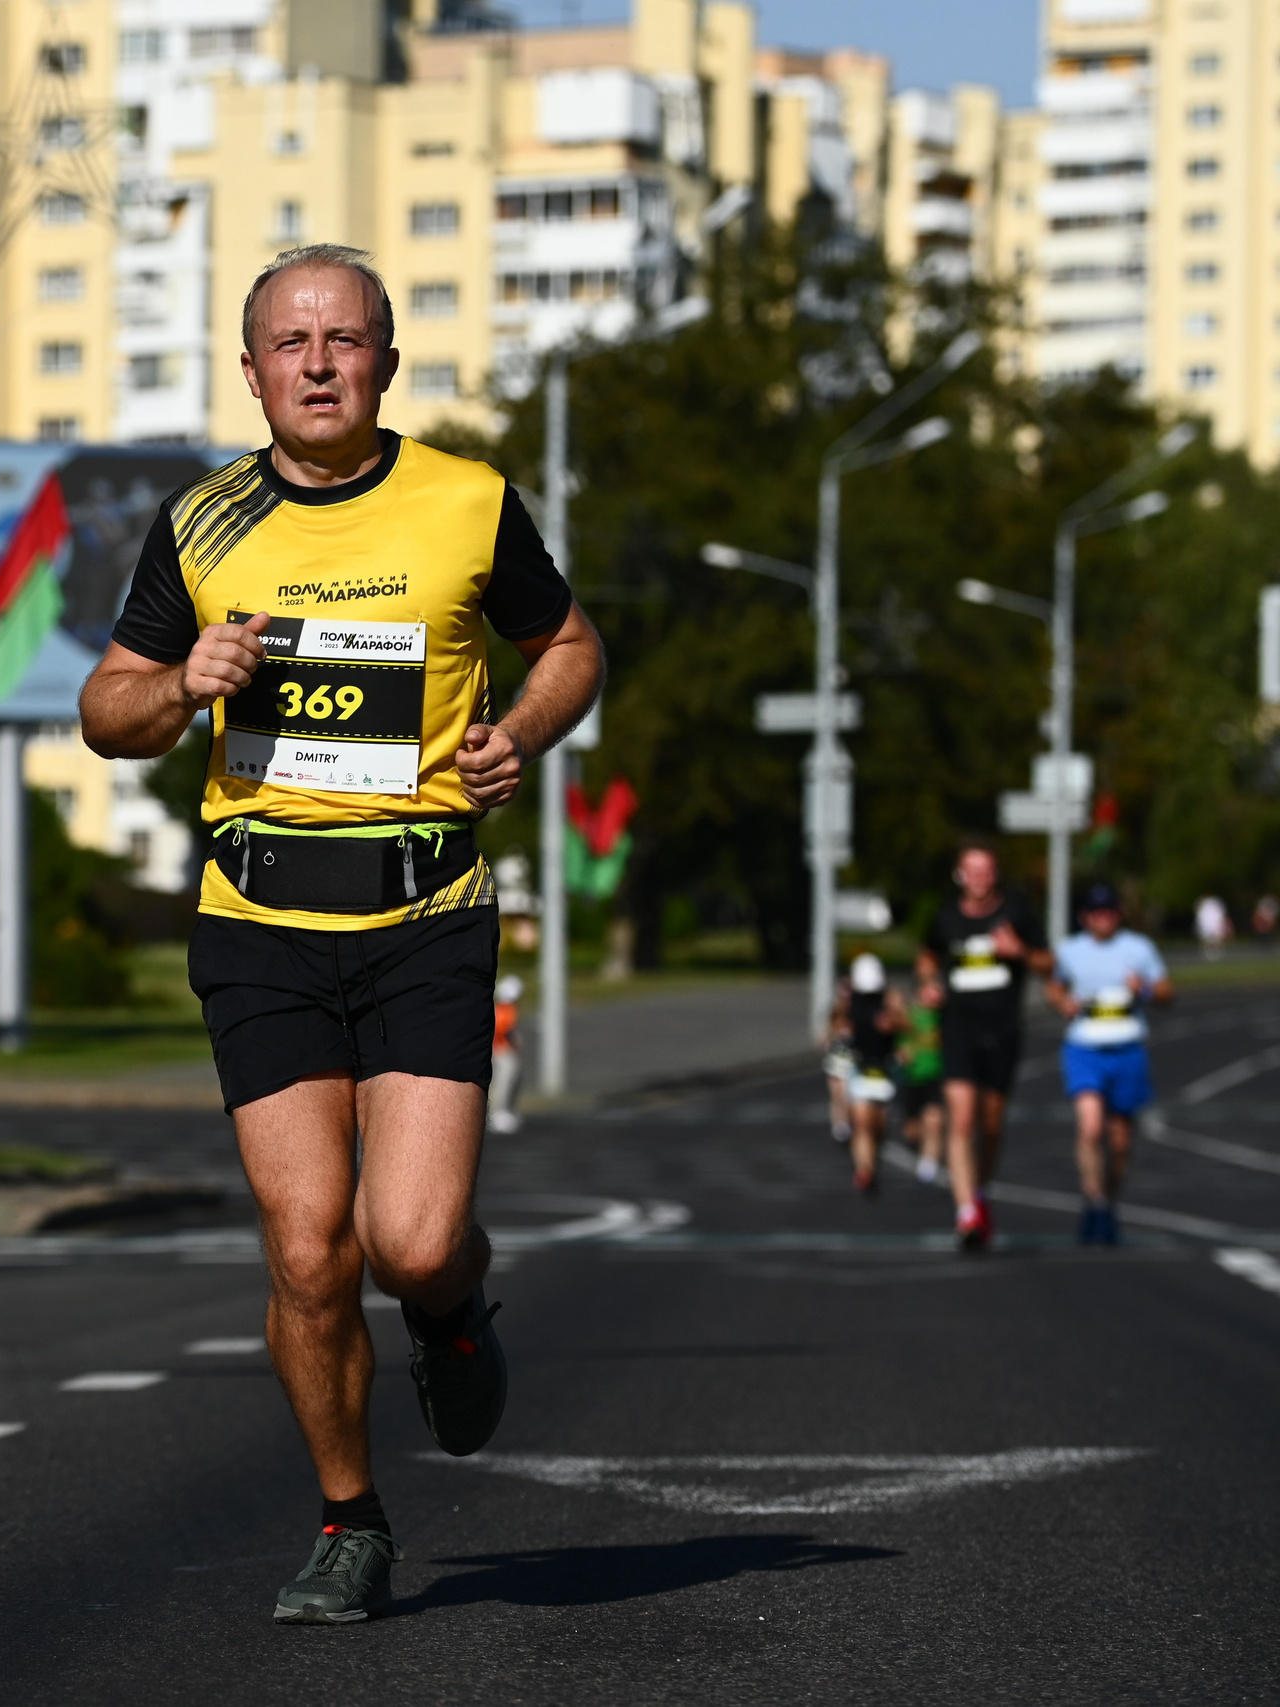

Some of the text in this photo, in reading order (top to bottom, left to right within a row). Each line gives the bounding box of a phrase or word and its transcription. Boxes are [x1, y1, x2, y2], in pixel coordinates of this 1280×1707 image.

[315, 583, 407, 603] МАРАФОН
[285, 598, 304, 606] 2023
[342, 640, 412, 651] МАРАФОН
[276, 681, 364, 720] 369
[295, 751, 339, 764] DMITRY
